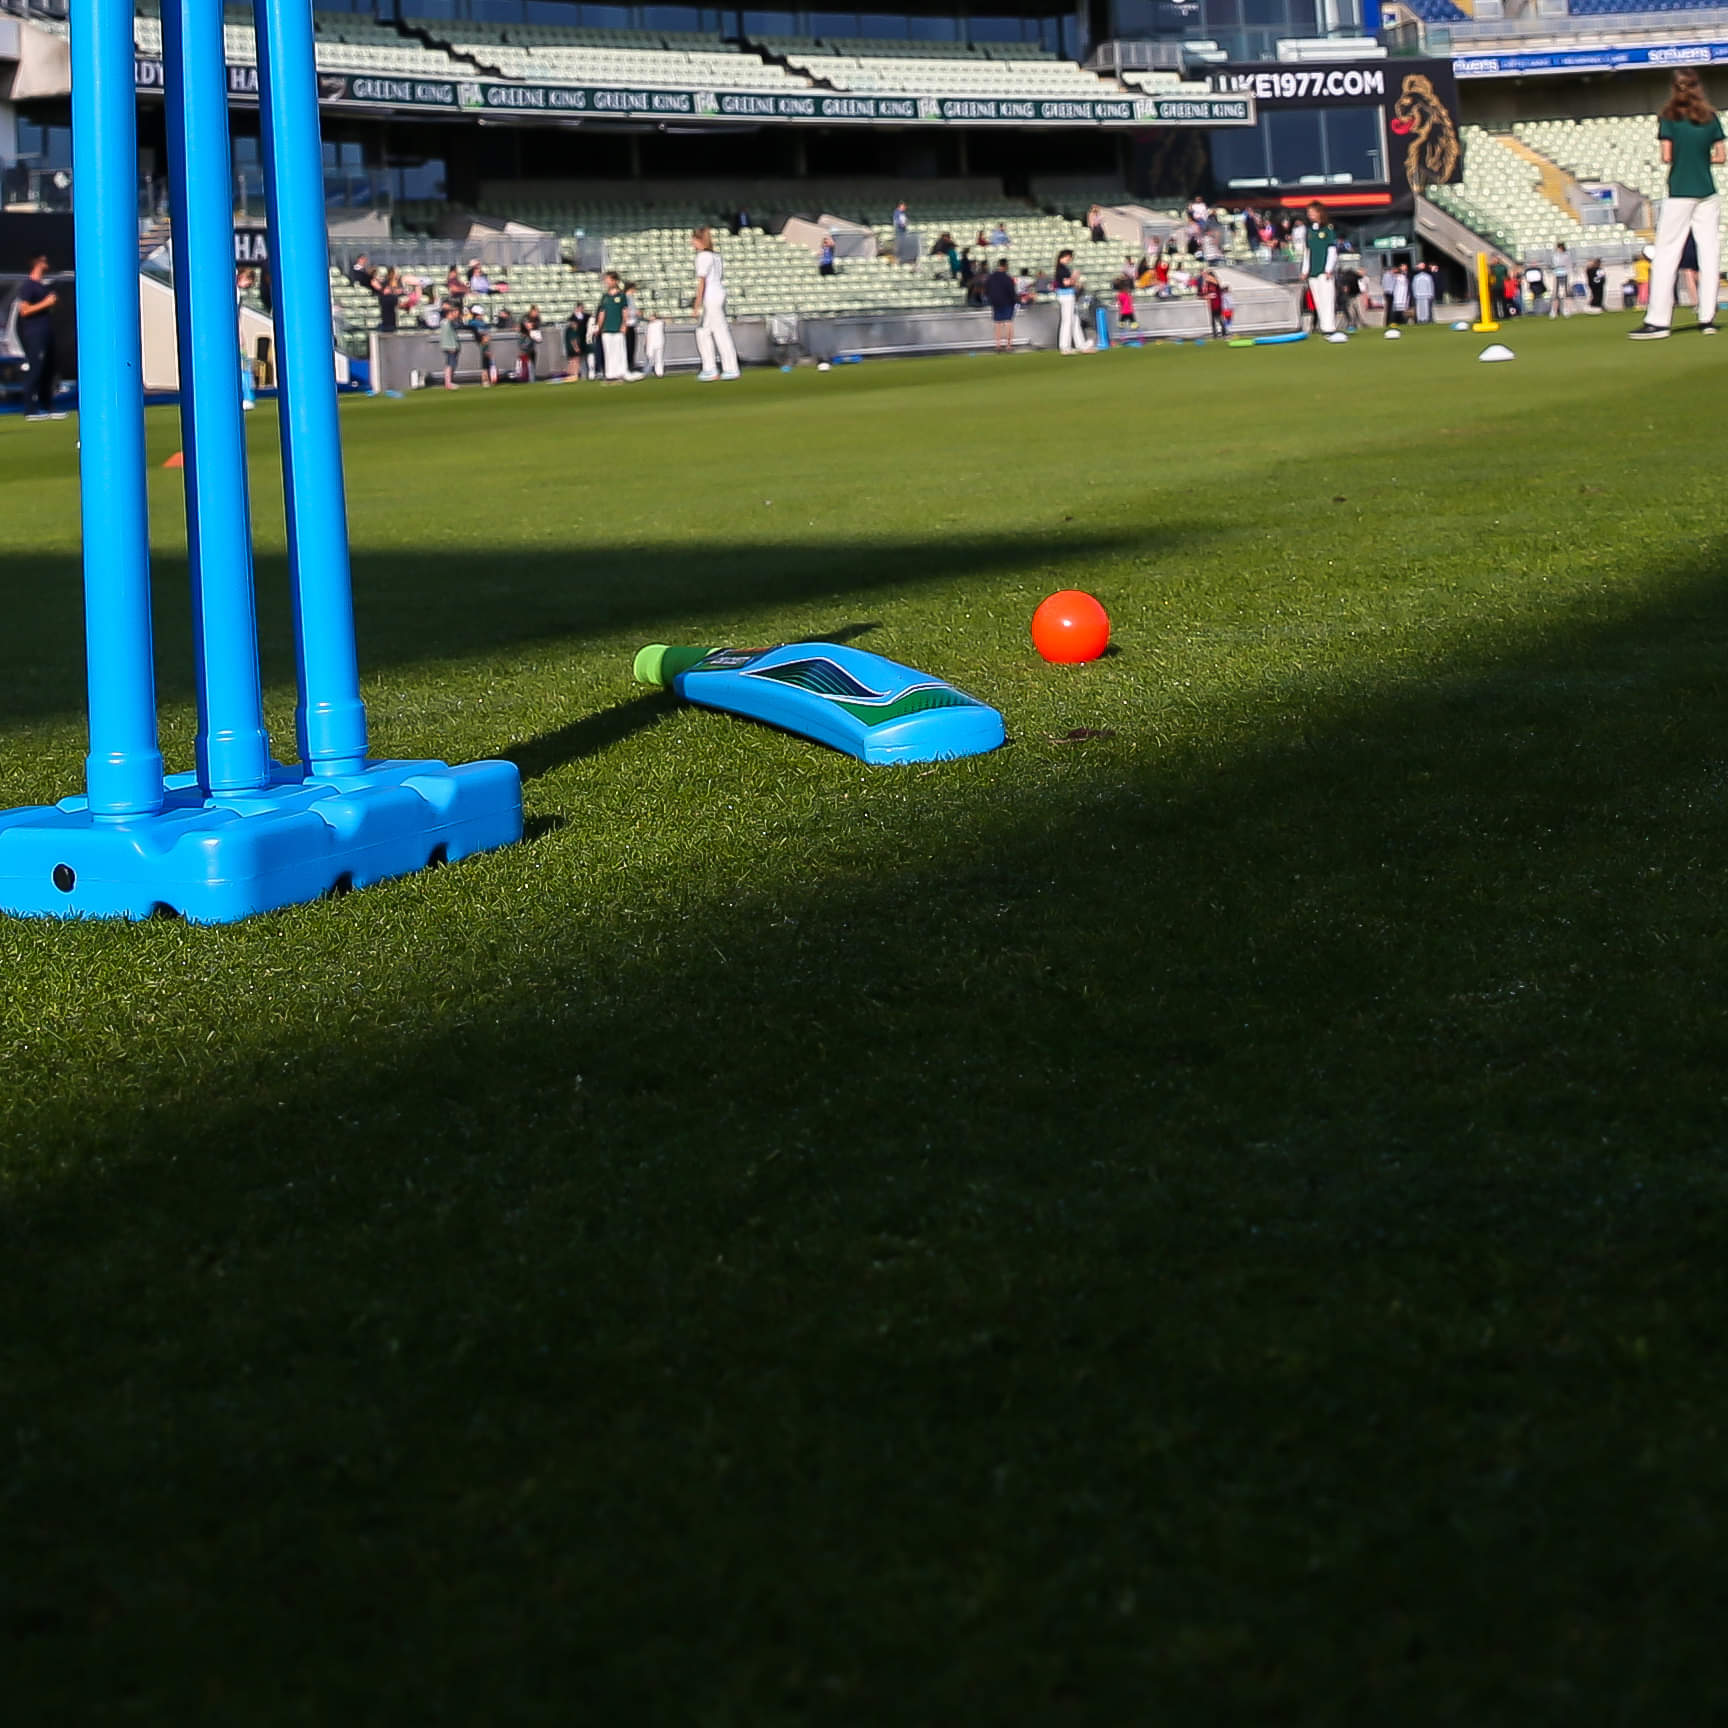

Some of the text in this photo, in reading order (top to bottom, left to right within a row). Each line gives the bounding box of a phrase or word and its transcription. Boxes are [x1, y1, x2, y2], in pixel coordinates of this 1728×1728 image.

[353, 79, 453, 103] GREENE KING
[488, 87, 586, 109] GREENE KING
[593, 91, 690, 112] GREENE KING
[722, 95, 815, 114] GREENE KING
[822, 97, 914, 117] GREENE KING
[943, 100, 1035, 118] GREENE KING
[1041, 101, 1131, 118] GREENE KING
[1160, 101, 1246, 119] GREENE KING
